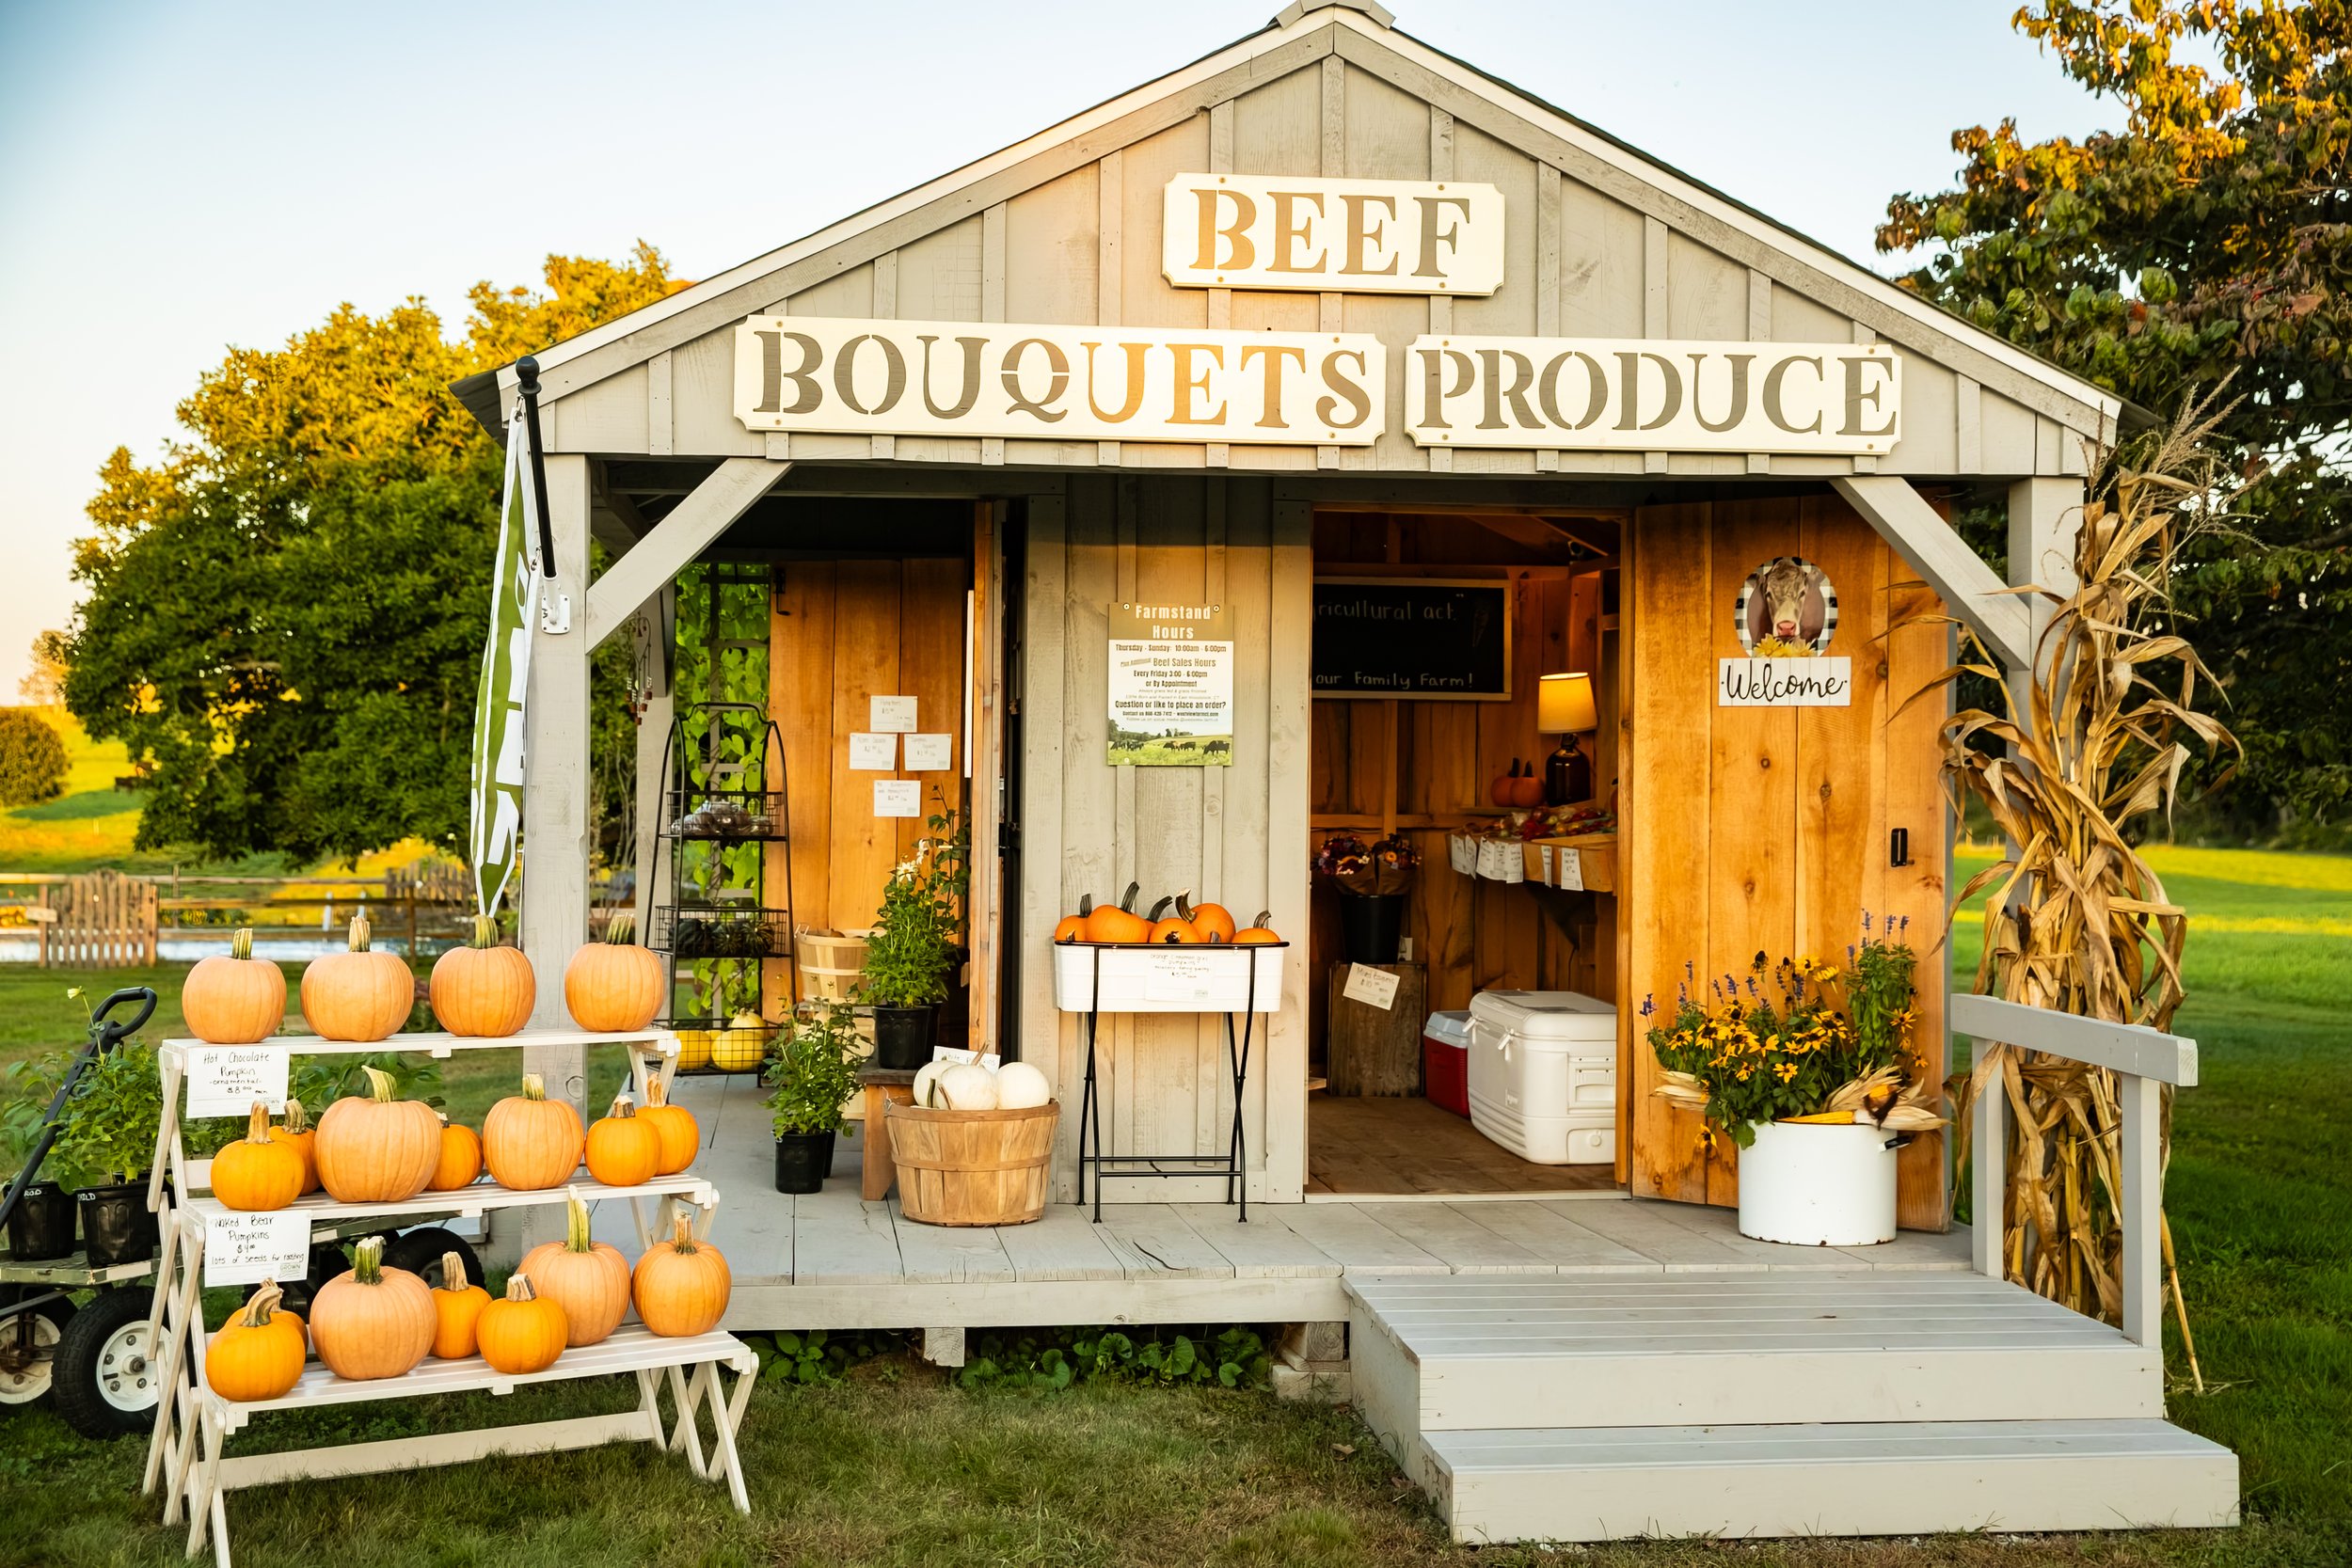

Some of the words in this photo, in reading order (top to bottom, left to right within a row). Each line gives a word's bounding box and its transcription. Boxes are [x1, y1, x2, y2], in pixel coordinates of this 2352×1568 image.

[1189, 188, 1470, 277] BEEF
[753, 330, 1372, 429] BOUQUETS
[1415, 349, 1897, 436] PRODUCE
[1136, 605, 1211, 620] Farmstand
[1152, 625, 1194, 640] Hours
[1116, 644, 1143, 653] Thursday
[1153, 657, 1170, 667] Beef
[1172, 657, 1193, 667] Sales
[1194, 657, 1216, 668] Hours
[1134, 670, 1149, 678] Every
[1151, 670, 1168, 678] Friday
[1354, 671, 1410, 689] Family
[1420, 672, 1473, 689] Farm!
[1726, 659, 1844, 702] Welcome
[1153, 680, 1160, 689] By
[1161, 680, 1198, 689] Appointment
[1115, 700, 1144, 708] Question
[1153, 700, 1166, 708] like
[1175, 701, 1194, 710] place
[1205, 701, 1227, 709] order?
[203, 1052, 218, 1065] Hot
[228, 1052, 270, 1064] Chocolate
[250, 1214, 275, 1227] Bear
[229, 1229, 270, 1243] Pumpkins
[212, 1257, 226, 1265] lots
[245, 1254, 267, 1263] seeds
